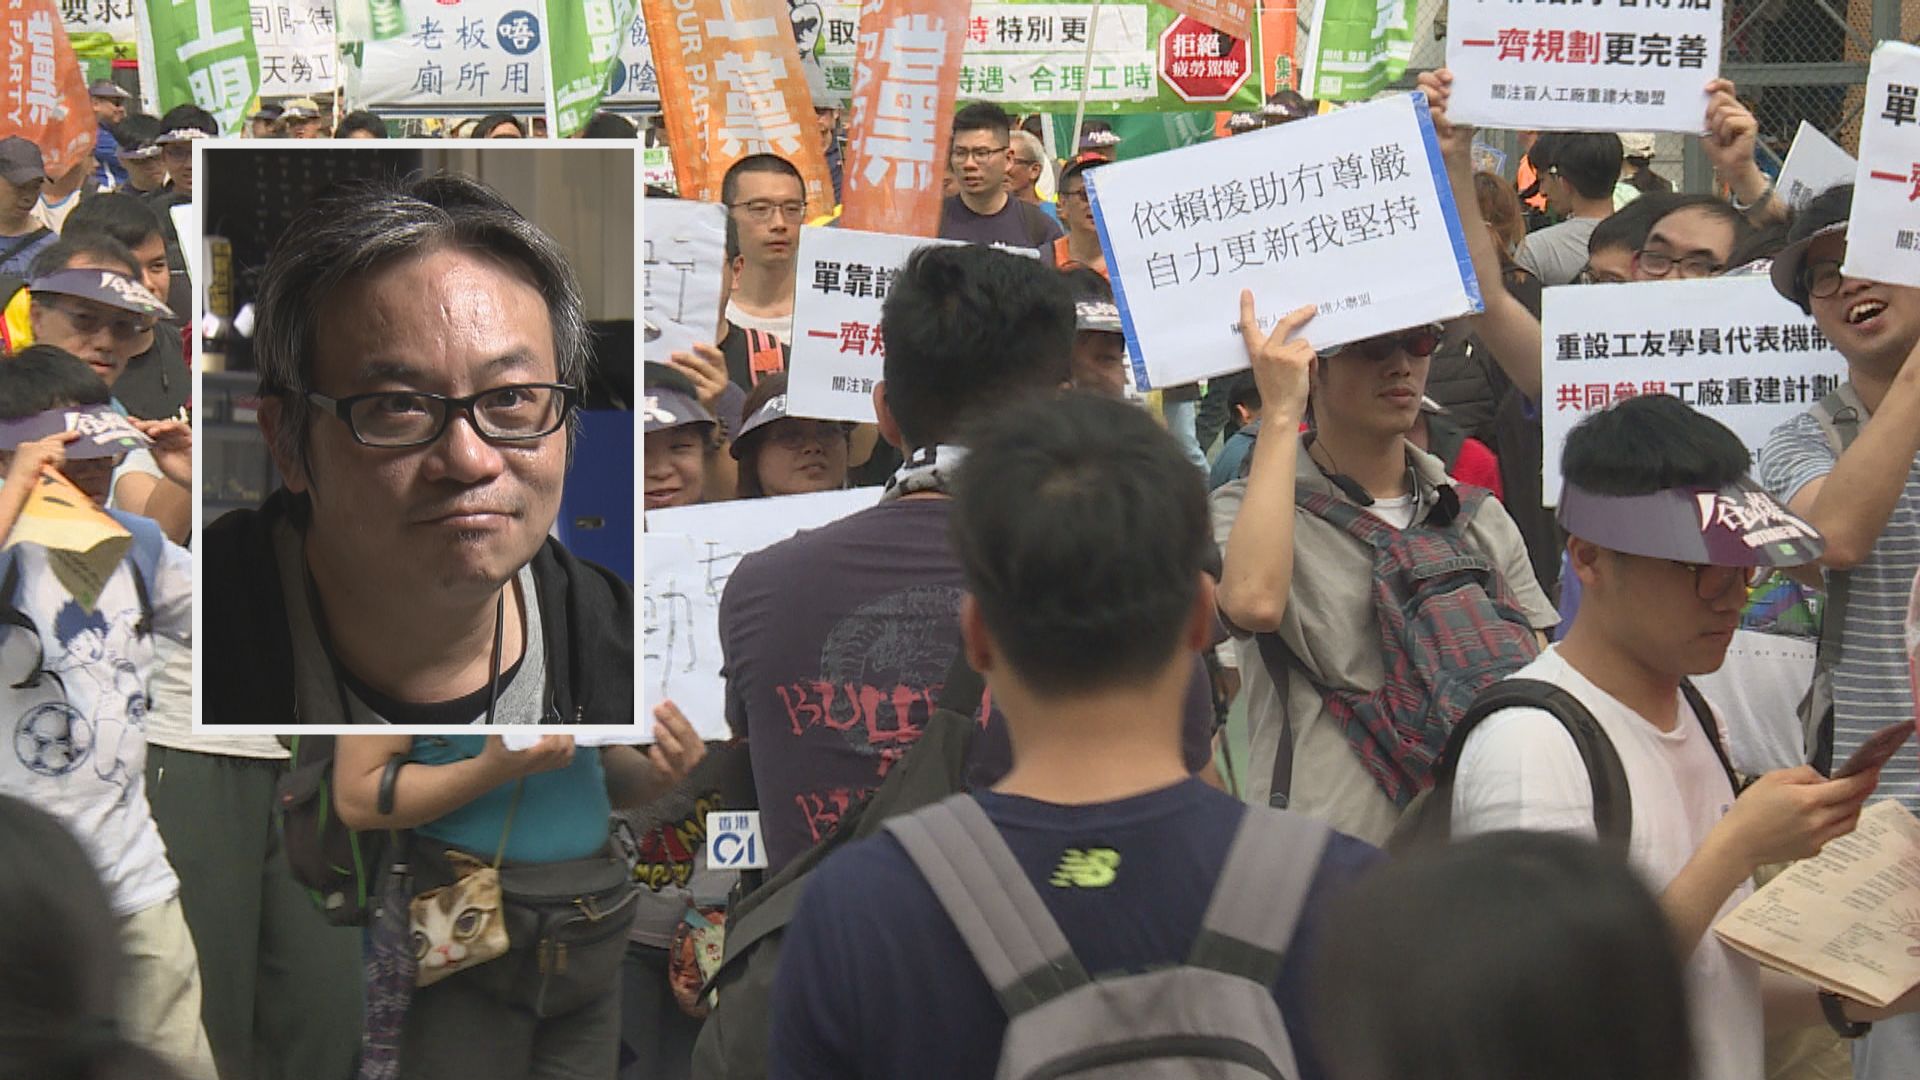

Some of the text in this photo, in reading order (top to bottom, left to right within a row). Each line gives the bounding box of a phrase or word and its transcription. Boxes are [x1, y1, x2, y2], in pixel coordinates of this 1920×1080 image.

[7, 20, 24, 127] PARTY
[1172, 32, 1221, 57] 拒絕
[1462, 28, 1708, 69] 一齊規劃更完善
[684, 64, 711, 163] PARTY
[863, 14, 947, 191] 黨
[1491, 84, 1666, 106] 關注盲人工廠重建大聯盟
[1131, 143, 1411, 240] 依賴援助冇尊嚴
[1147, 195, 1421, 290] 自力更新我堅持
